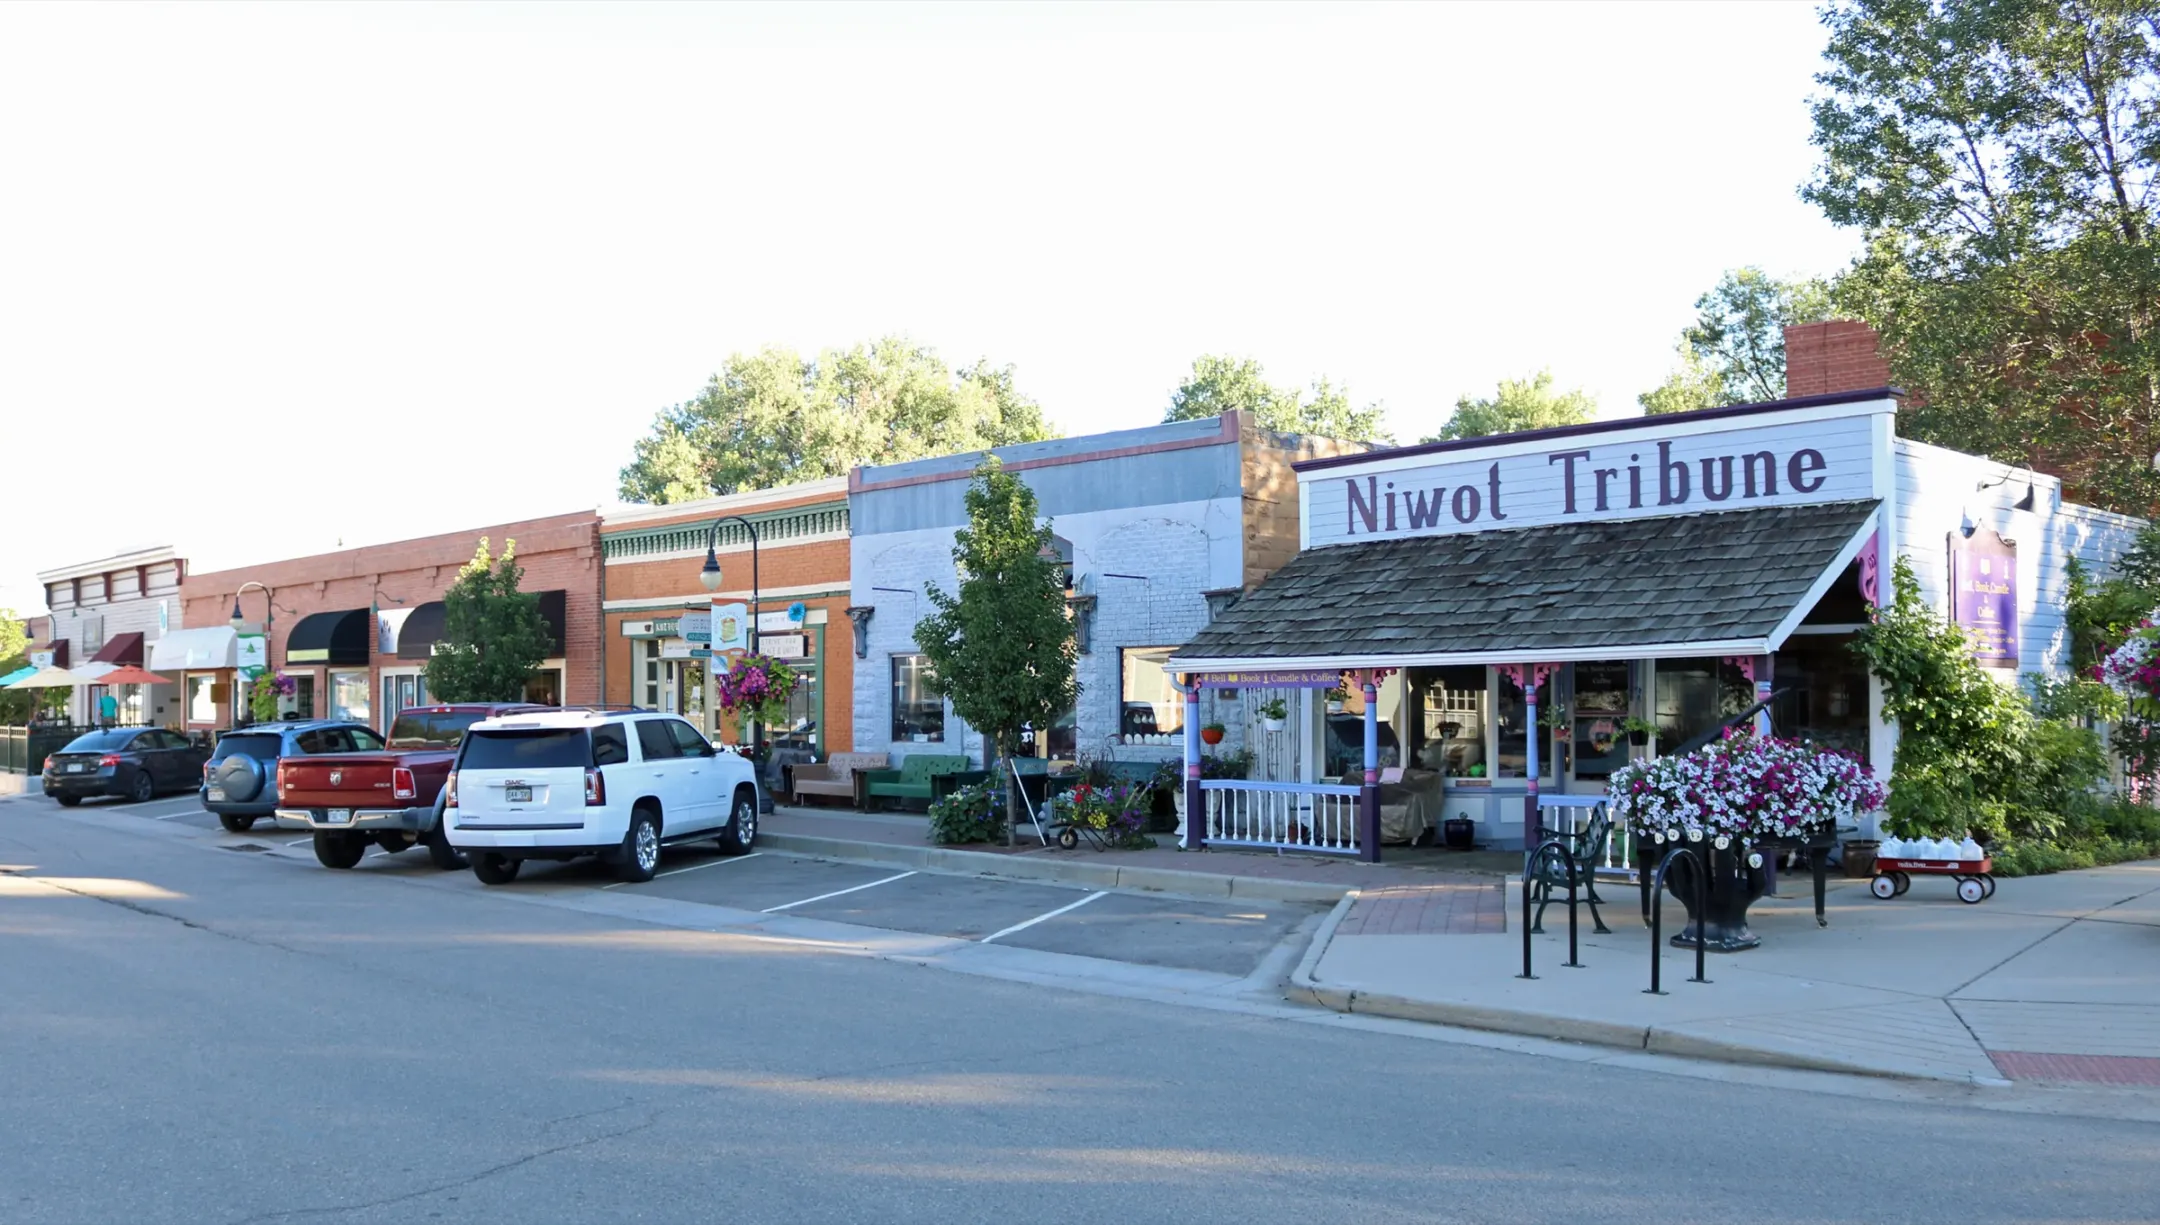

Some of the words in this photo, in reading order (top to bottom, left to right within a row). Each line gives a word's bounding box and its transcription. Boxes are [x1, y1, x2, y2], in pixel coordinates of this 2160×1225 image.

[1346, 461, 1507, 535] Niwot
[1549, 441, 1827, 515] Tribune
[1211, 673, 1226, 683] Bell
[1240, 673, 1260, 683] Book
[1270, 672, 1300, 683] Candle
[1301, 672, 1309, 682] &
[1310, 672, 1337, 682] Coffee
